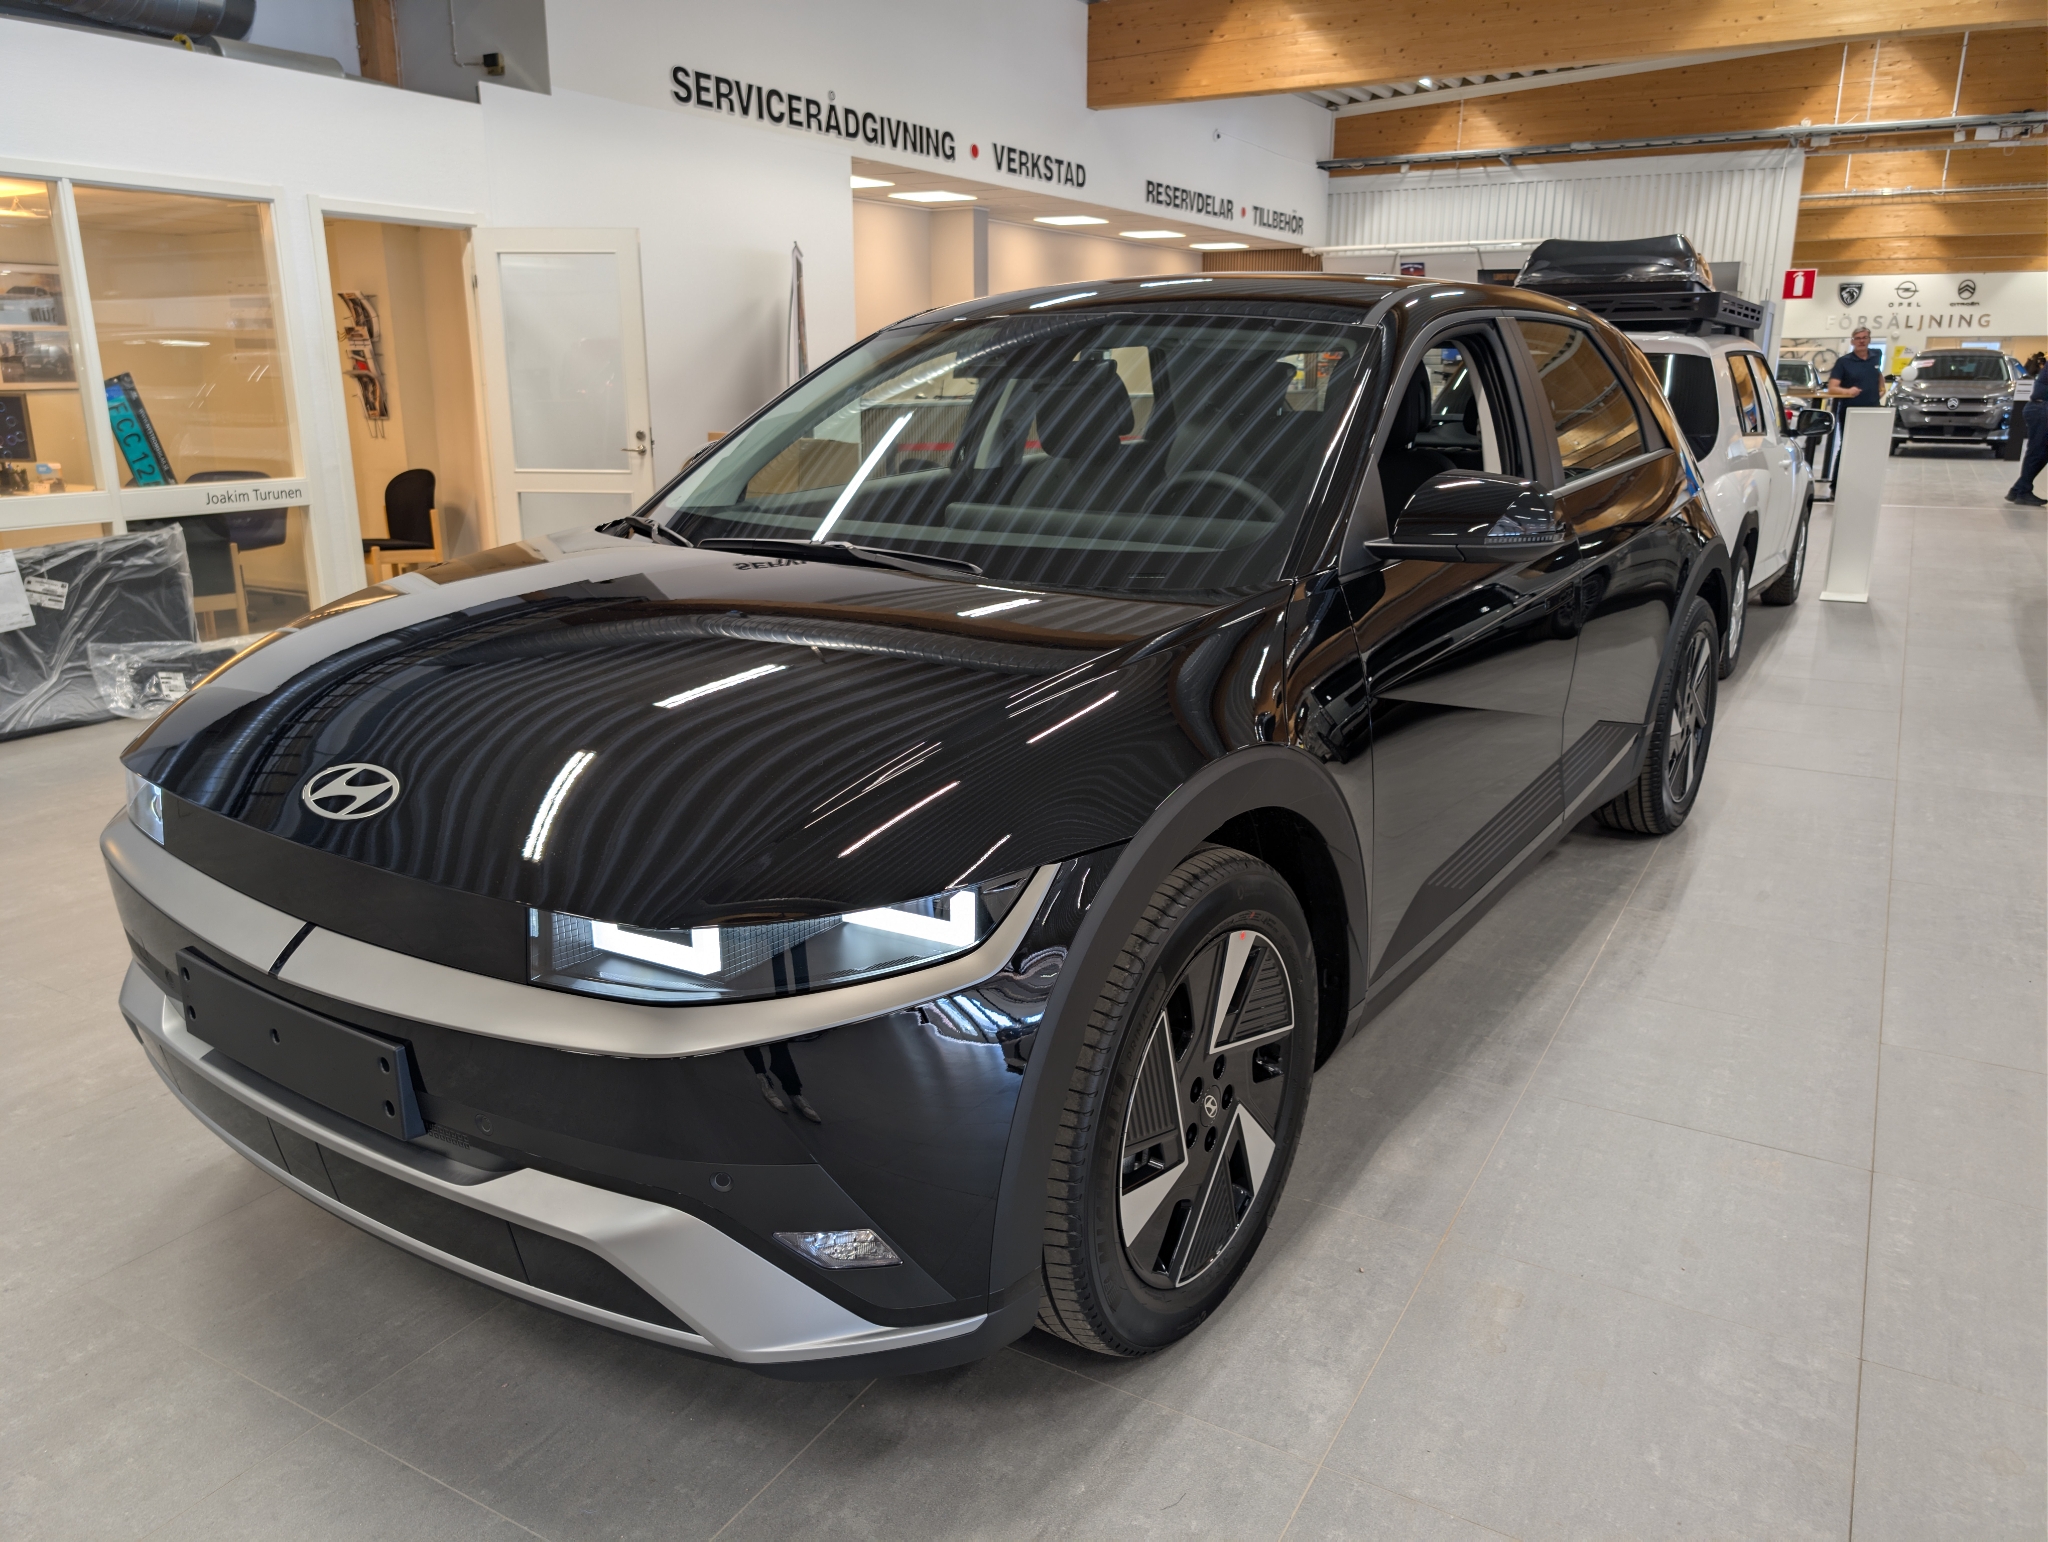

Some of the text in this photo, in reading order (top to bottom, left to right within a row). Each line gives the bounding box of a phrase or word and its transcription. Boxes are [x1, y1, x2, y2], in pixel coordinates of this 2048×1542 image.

[671, 65, 1087, 188] SERVICERÅDGIVNING VERKSTAD
[1146, 179, 1304, 235] RESERVDELAR TILLBEHÖR
[1826, 312, 1991, 331] FÖRSÄLJNING
[108, 402, 141, 448] FCC
[206, 488, 302, 505] Joakim Turunen
